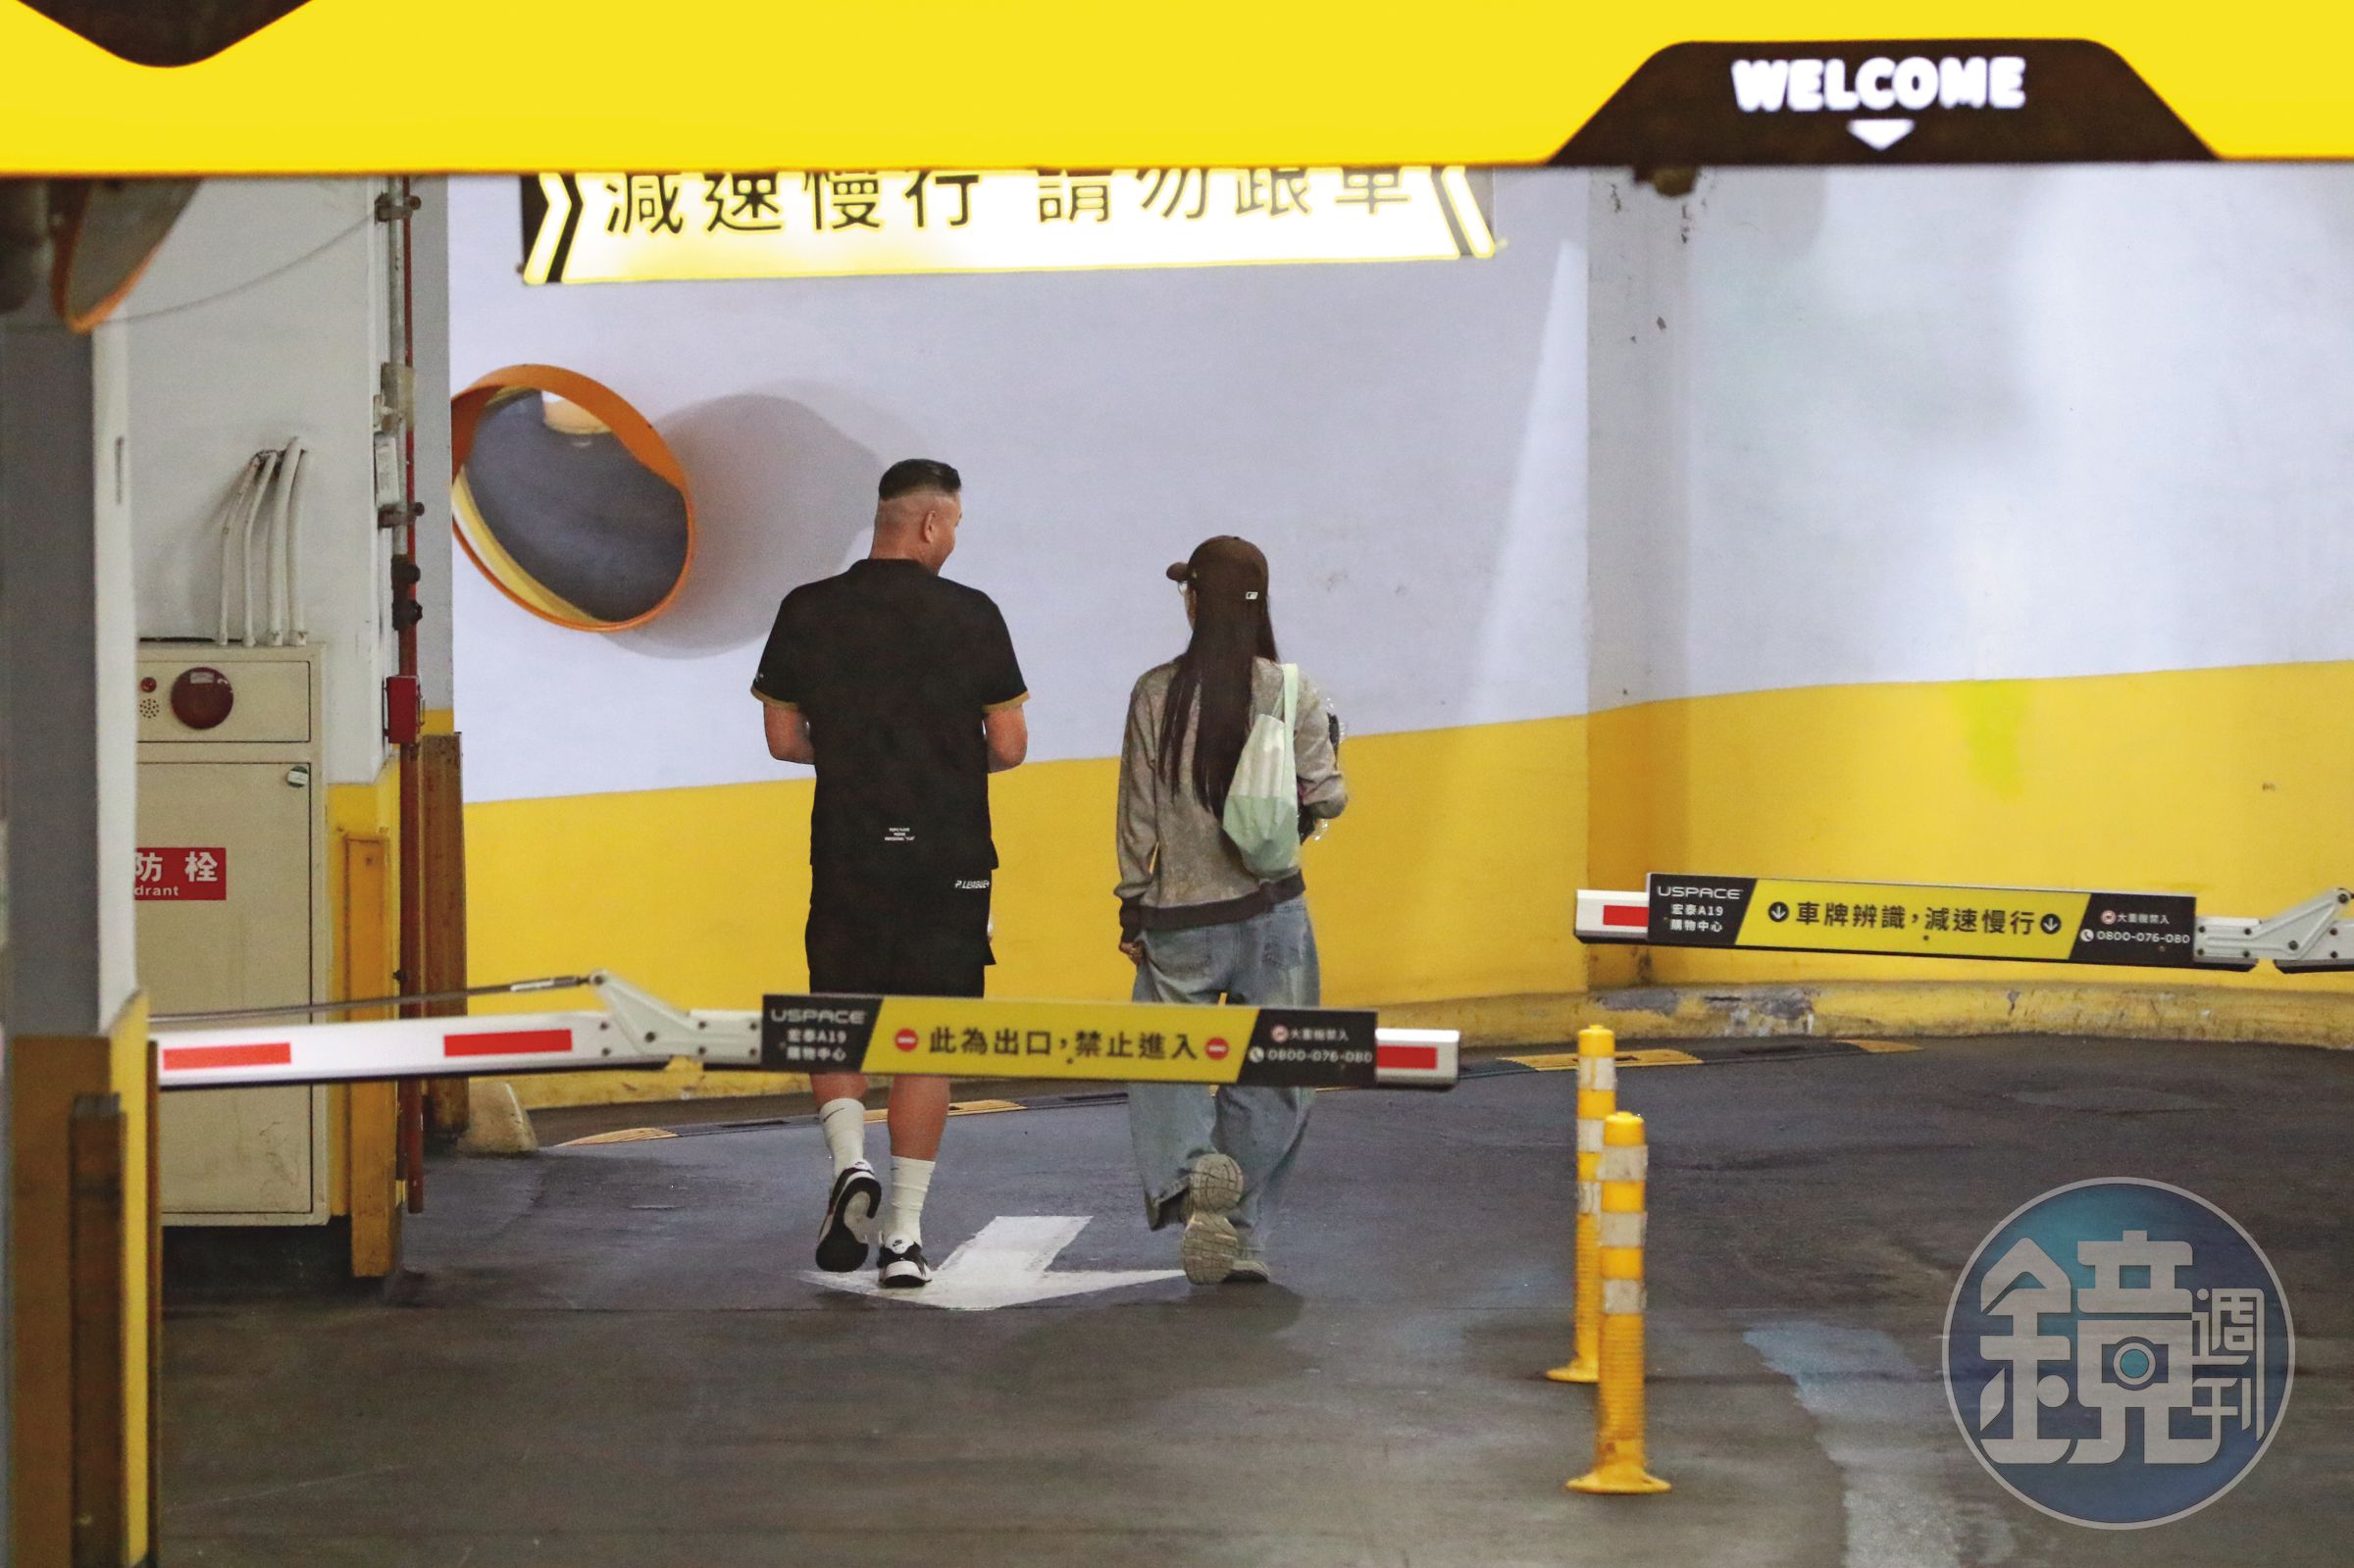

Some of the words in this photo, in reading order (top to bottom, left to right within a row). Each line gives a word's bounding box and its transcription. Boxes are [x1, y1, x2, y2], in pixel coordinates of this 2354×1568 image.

[1731, 56, 2026, 113] WELCOME
[605, 171, 980, 233] 減速慢行
[1658, 885, 1743, 900] USPACE
[2097, 931, 2191, 943] 0800-076-080
[770, 1008, 866, 1025] USPACE
